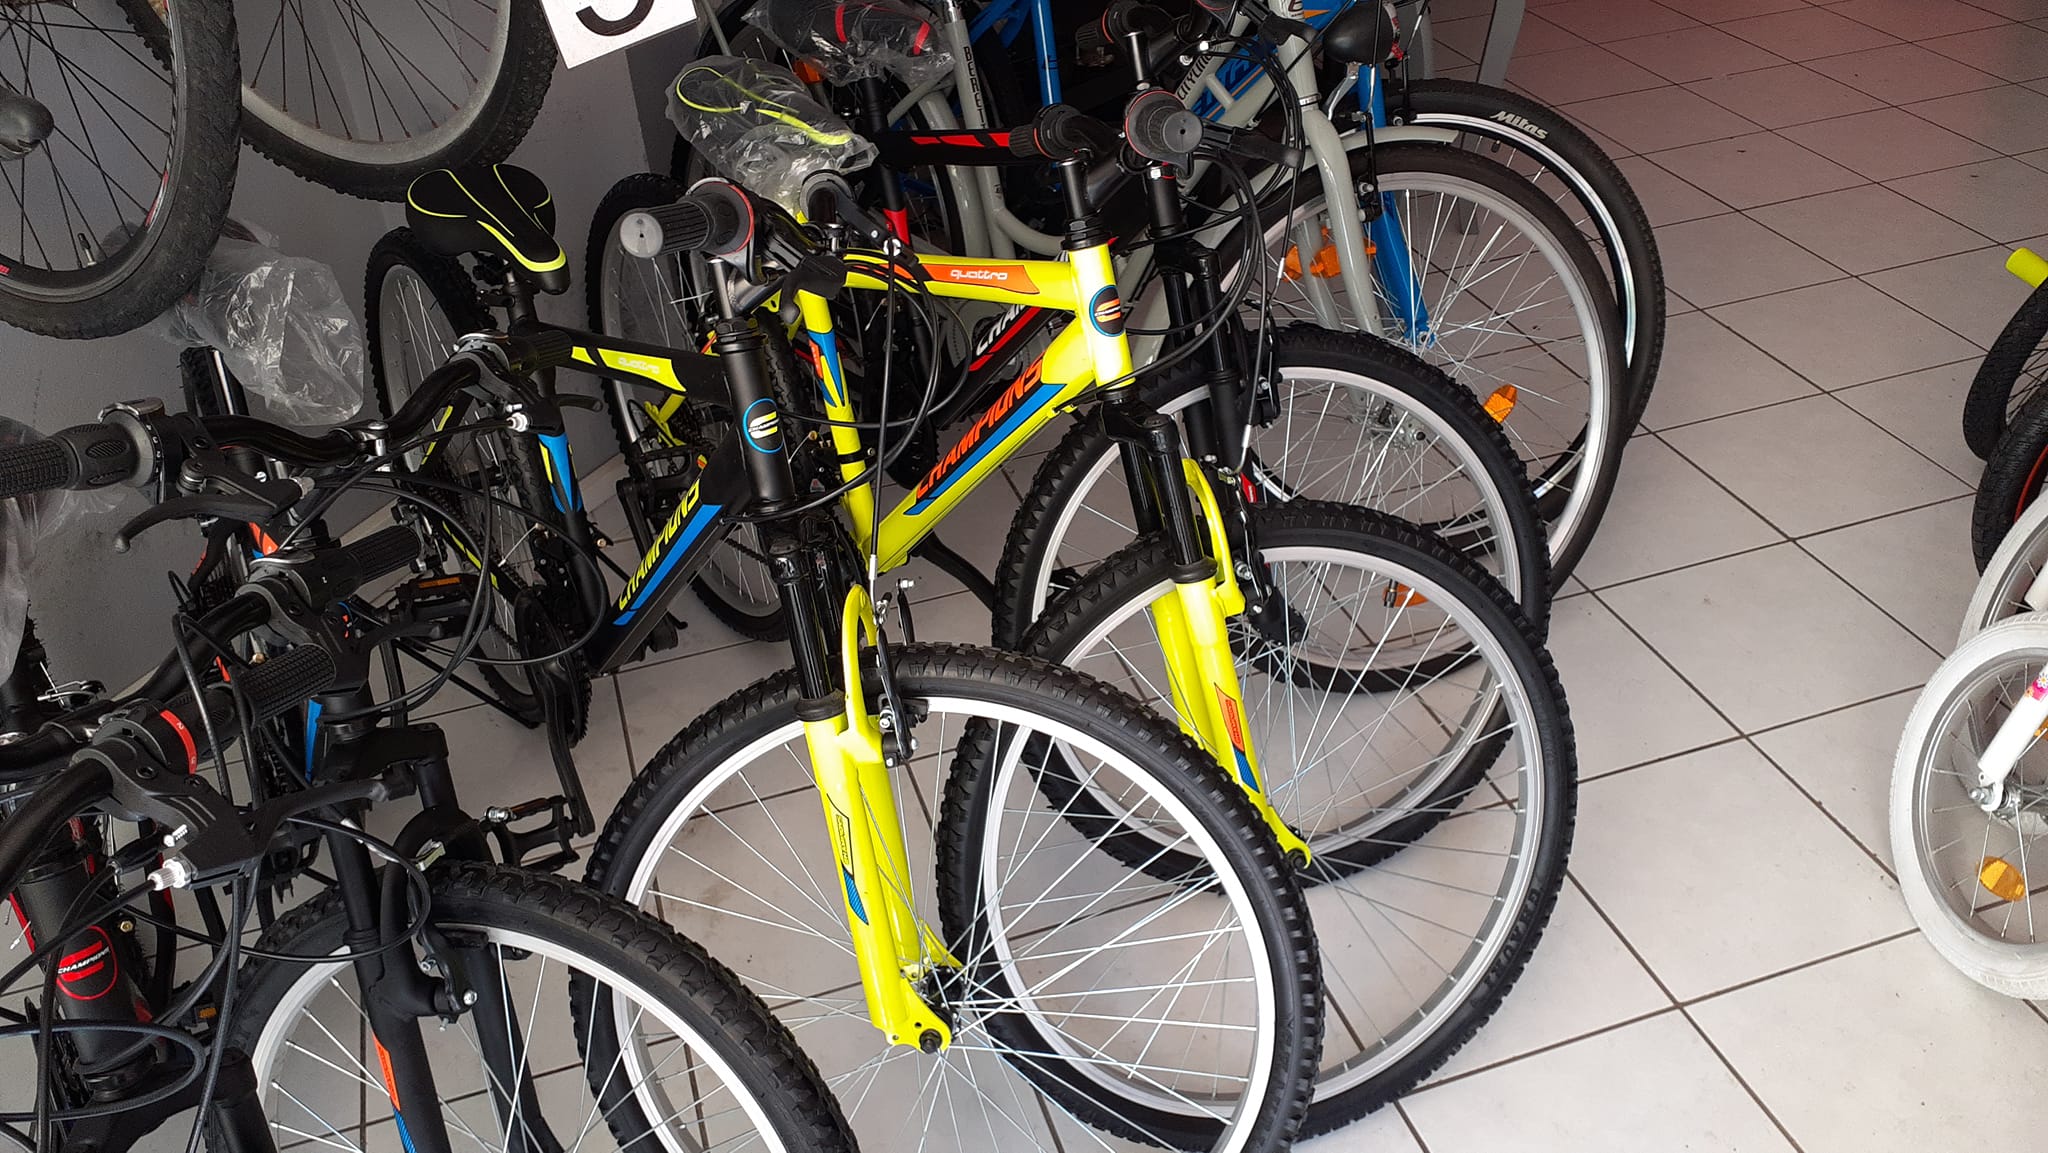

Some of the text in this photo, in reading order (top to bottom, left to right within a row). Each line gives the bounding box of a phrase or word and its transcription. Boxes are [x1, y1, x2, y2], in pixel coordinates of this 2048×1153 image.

[963, 46, 986, 129] BERET
[1490, 110, 1548, 139] Mitas
[950, 269, 1008, 280] quattro
[916, 353, 1043, 499] CHAMPIONS
[619, 478, 699, 611] CHAMPIONS
